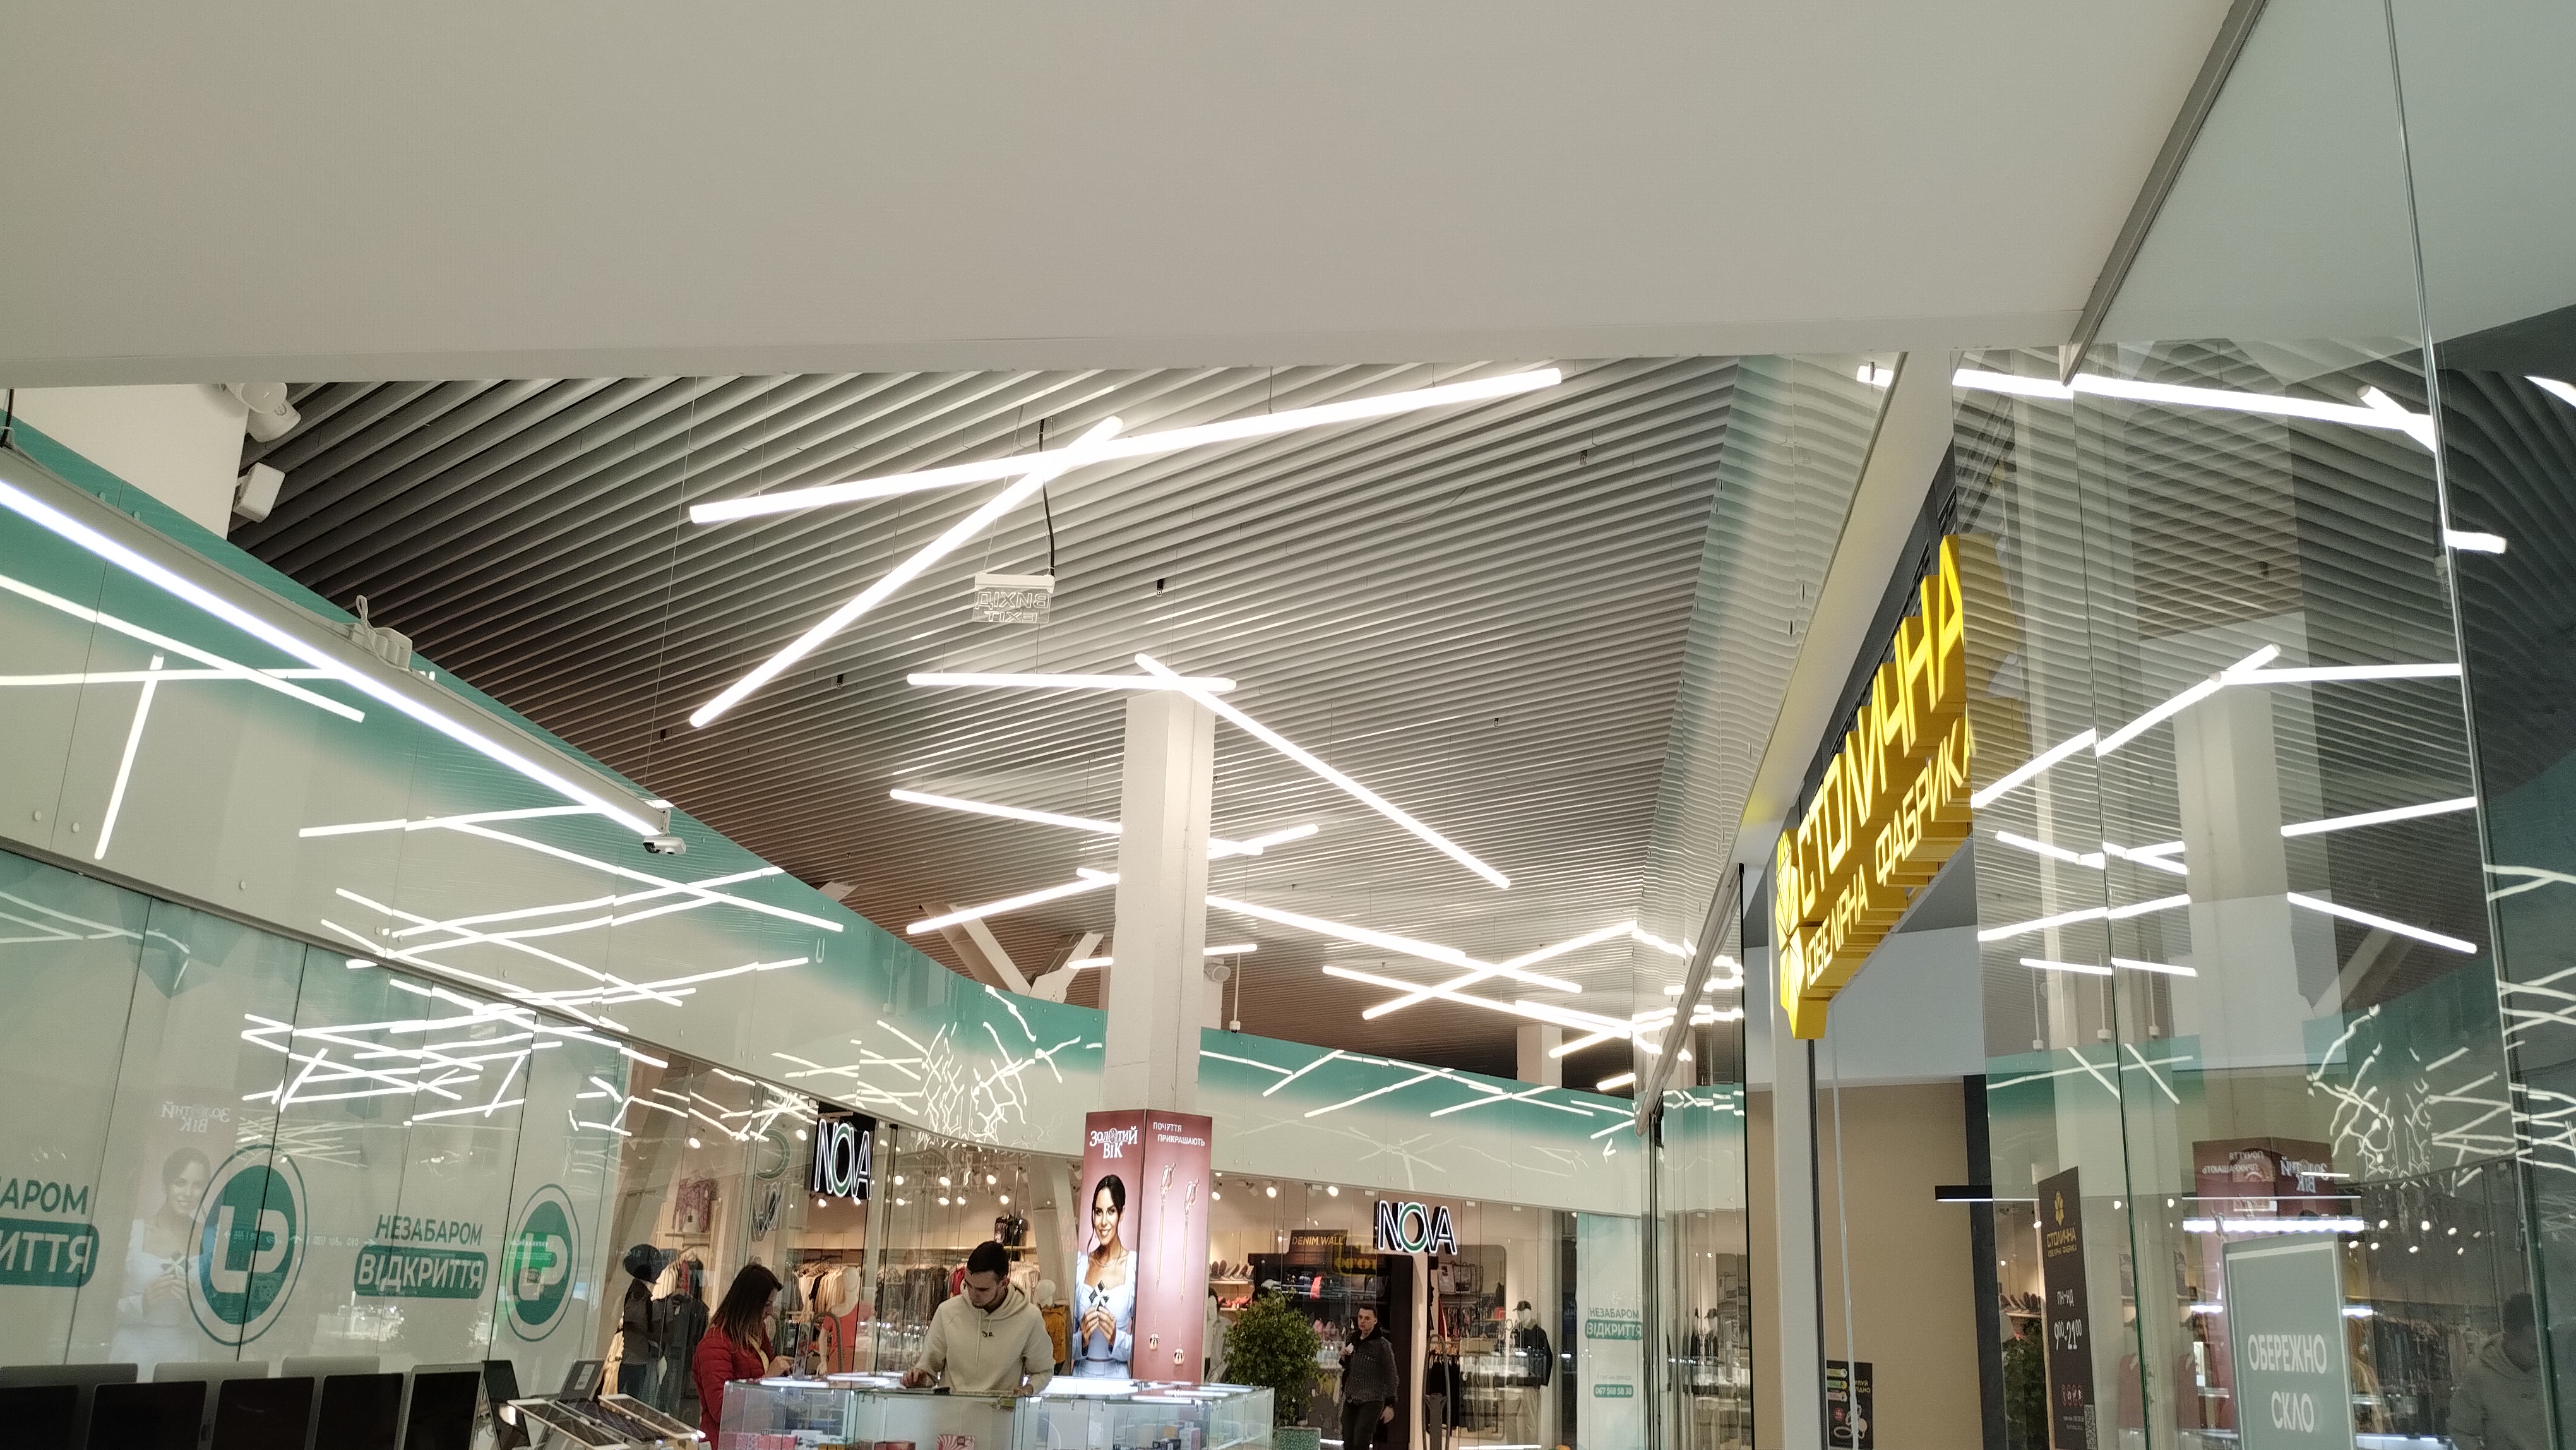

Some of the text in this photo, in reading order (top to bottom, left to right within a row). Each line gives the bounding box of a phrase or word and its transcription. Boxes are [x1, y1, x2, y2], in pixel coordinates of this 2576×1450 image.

[1797, 535, 1964, 918] СТОЛИЧНА
[1806, 864, 1869, 990] ЮВЕЛІРНА
[1089, 1126, 1138, 1147] ЗОЛОТИЙ
[1153, 1122, 1182, 1132] ПОЧУТТЯ
[1157, 1134, 1205, 1147] ПРИКРАШАЮТЬ
[814, 1118, 871, 1200] NOVA
[1103, 1142, 1123, 1159] ВІК
[0, 1177, 89, 1215] АРОМ
[375, 1214, 483, 1246] НЕЗАБАРОМ
[1292, 1236, 1344, 1245] DENIM WALL
[1376, 1200, 1457, 1255] NOVA
[357, 1254, 485, 1293] ВІДКРИТТЯ
[1589, 1307, 1640, 1320] НЕЗАБАРОМ
[1587, 1322, 1642, 1338] ВІДКРИТТЯ
[2247, 1334, 2327, 1375] ОБЕРЕЖНО
[1595, 1386, 1606, 1395] 067
[2272, 1391, 2315, 1434] СКЛО
